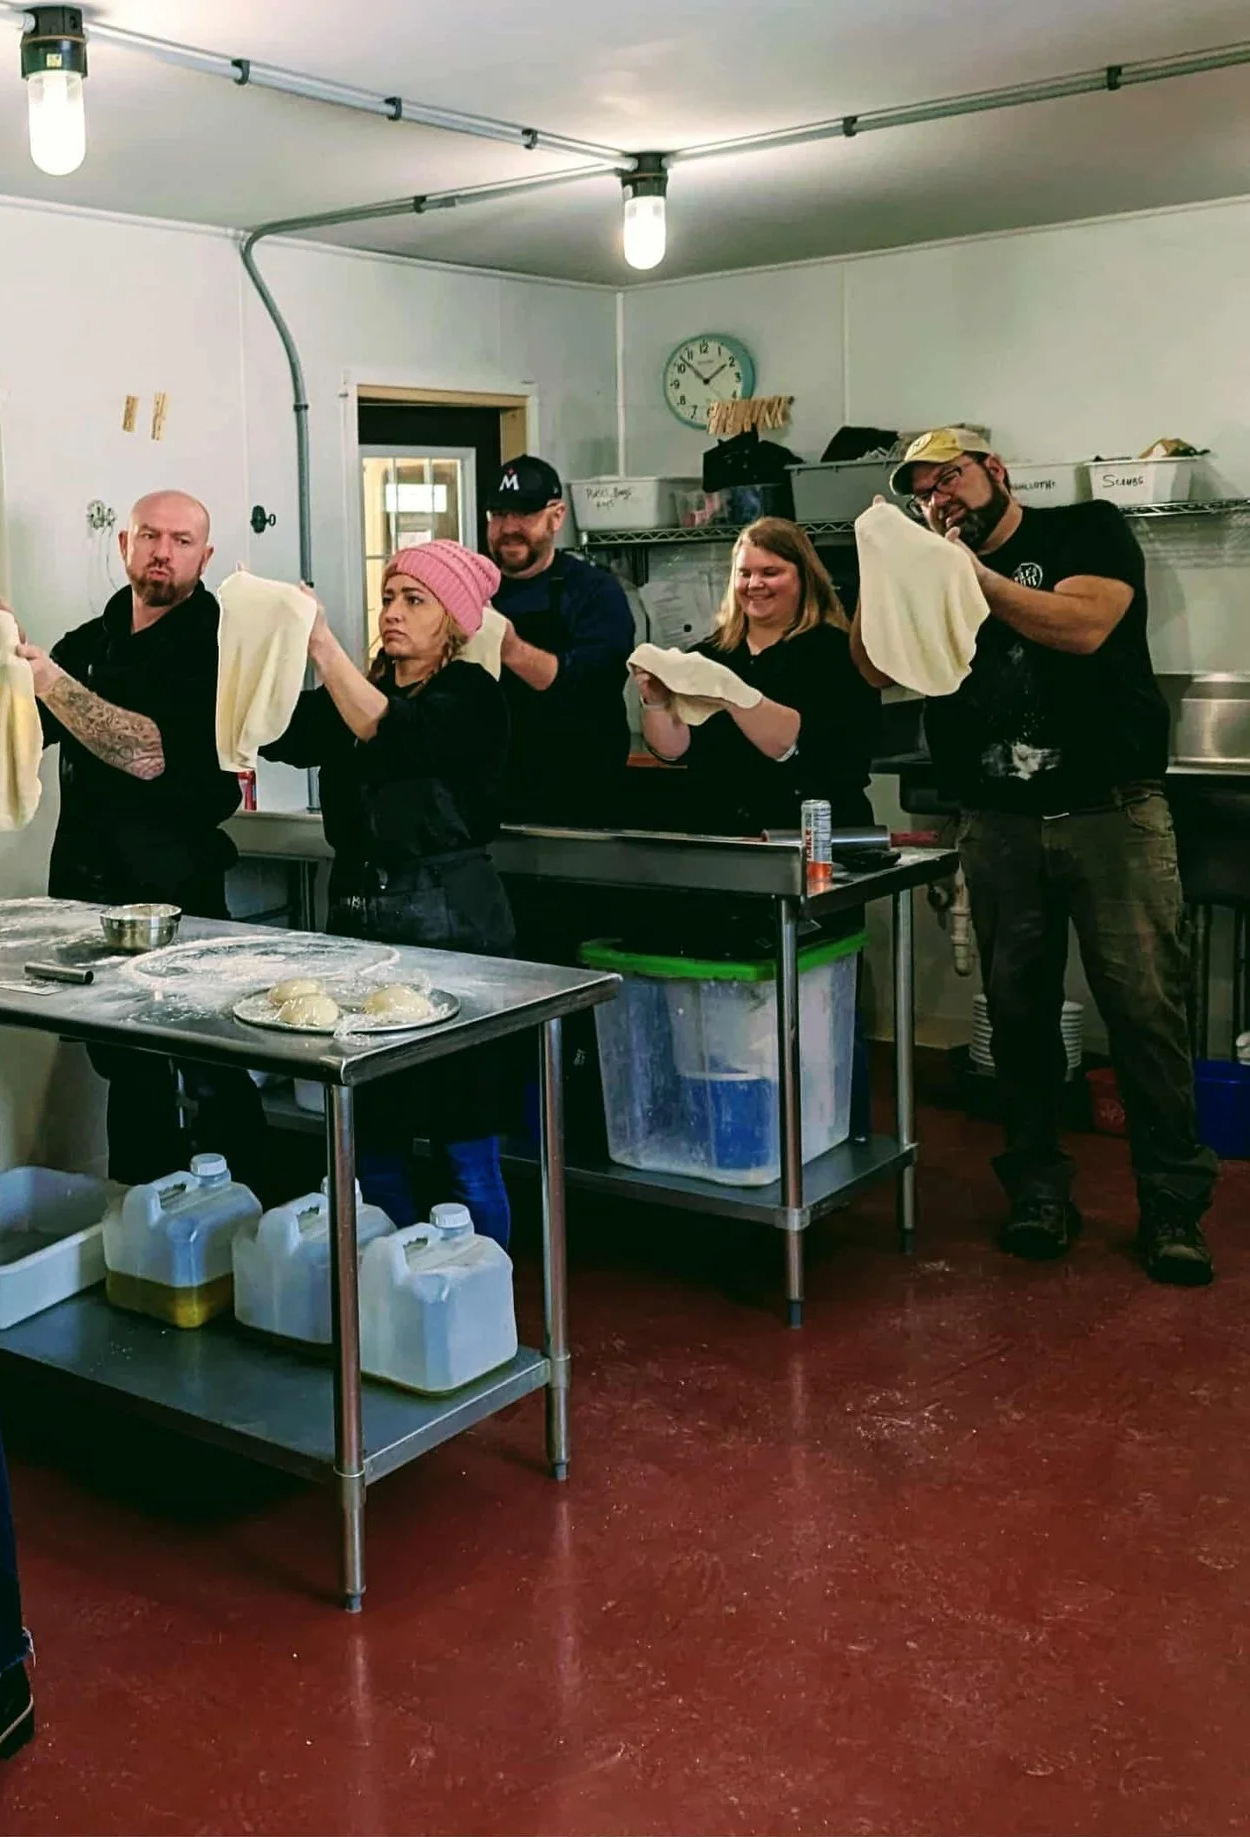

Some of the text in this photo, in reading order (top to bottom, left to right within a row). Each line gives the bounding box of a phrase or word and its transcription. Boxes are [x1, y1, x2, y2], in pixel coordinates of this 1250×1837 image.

[699, 343, 709, 354] 12
[728, 356, 736, 368] 2
[677, 363, 686, 374] 10
[498, 474, 520, 492] M
